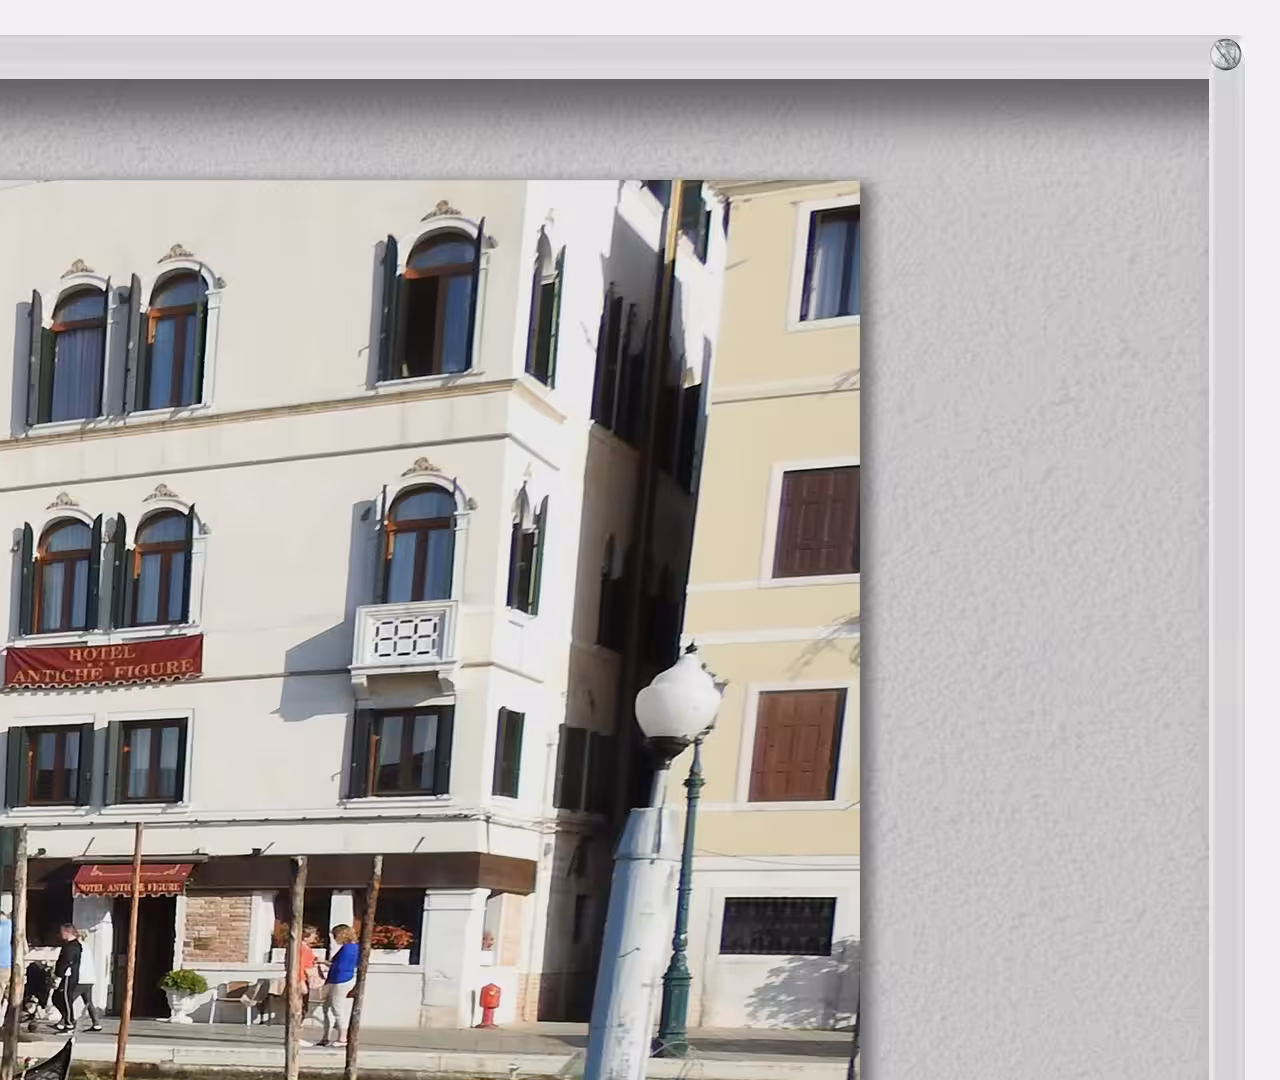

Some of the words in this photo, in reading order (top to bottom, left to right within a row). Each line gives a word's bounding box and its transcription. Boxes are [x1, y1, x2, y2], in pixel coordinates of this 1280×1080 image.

[69, 645, 136, 662] HOTEL
[12, 667, 103, 683] ANTICHE
[114, 658, 194, 678] FIGURE
[107, 882, 146, 892] ANTICE
[147, 882, 181, 891] FIGURE
